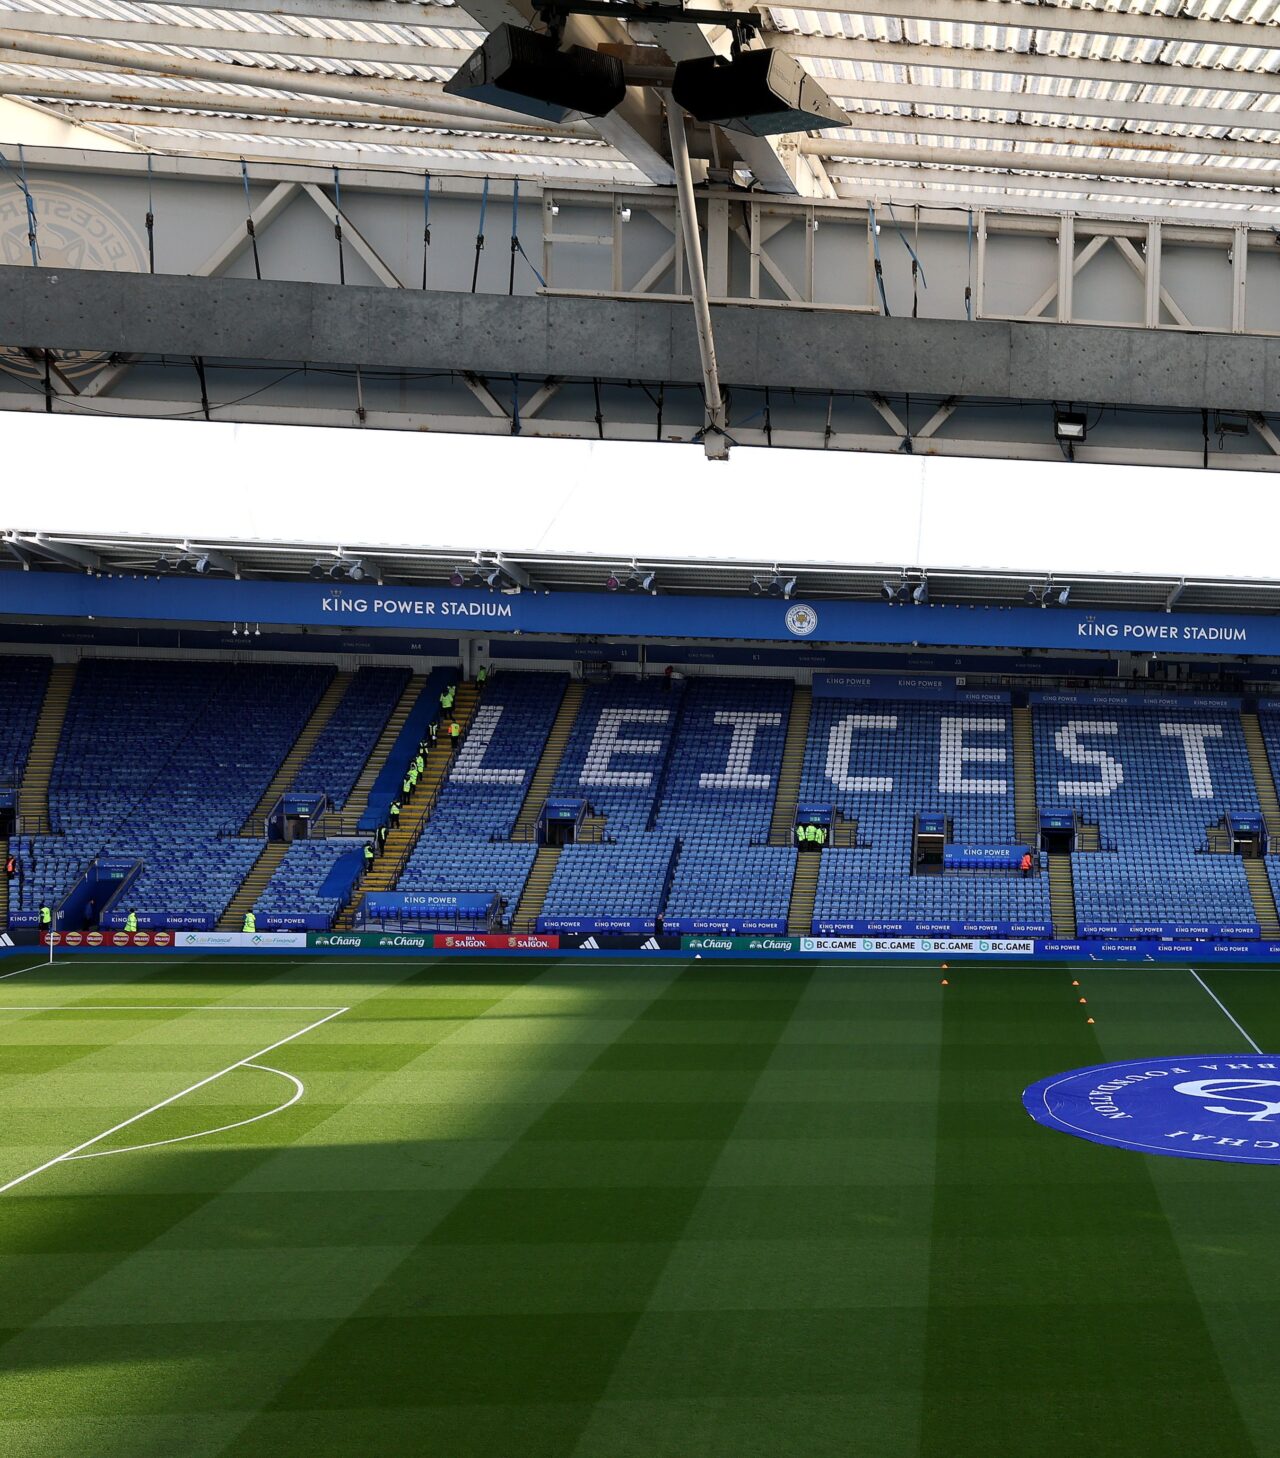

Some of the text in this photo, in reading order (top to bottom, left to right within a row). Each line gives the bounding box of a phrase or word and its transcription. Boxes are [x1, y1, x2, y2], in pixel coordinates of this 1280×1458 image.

[322, 598, 511, 616] KING POWER STADIUM
[1078, 624, 1246, 641] KING POWER STADIUM
[404, 896, 456, 904] KING POWER
[330, 937, 361, 947] Chang
[394, 937, 424, 947] Chang
[703, 939, 732, 949] Chang
[763, 939, 792, 950] Chang
[816, 940, 856, 949] BC.GAME
[876, 941, 916, 950] BC.GAME
[934, 942, 974, 950] BC.GAME
[991, 942, 1031, 951] BC.GAME
[1088, 1066, 1192, 1121] FOUNDATION
